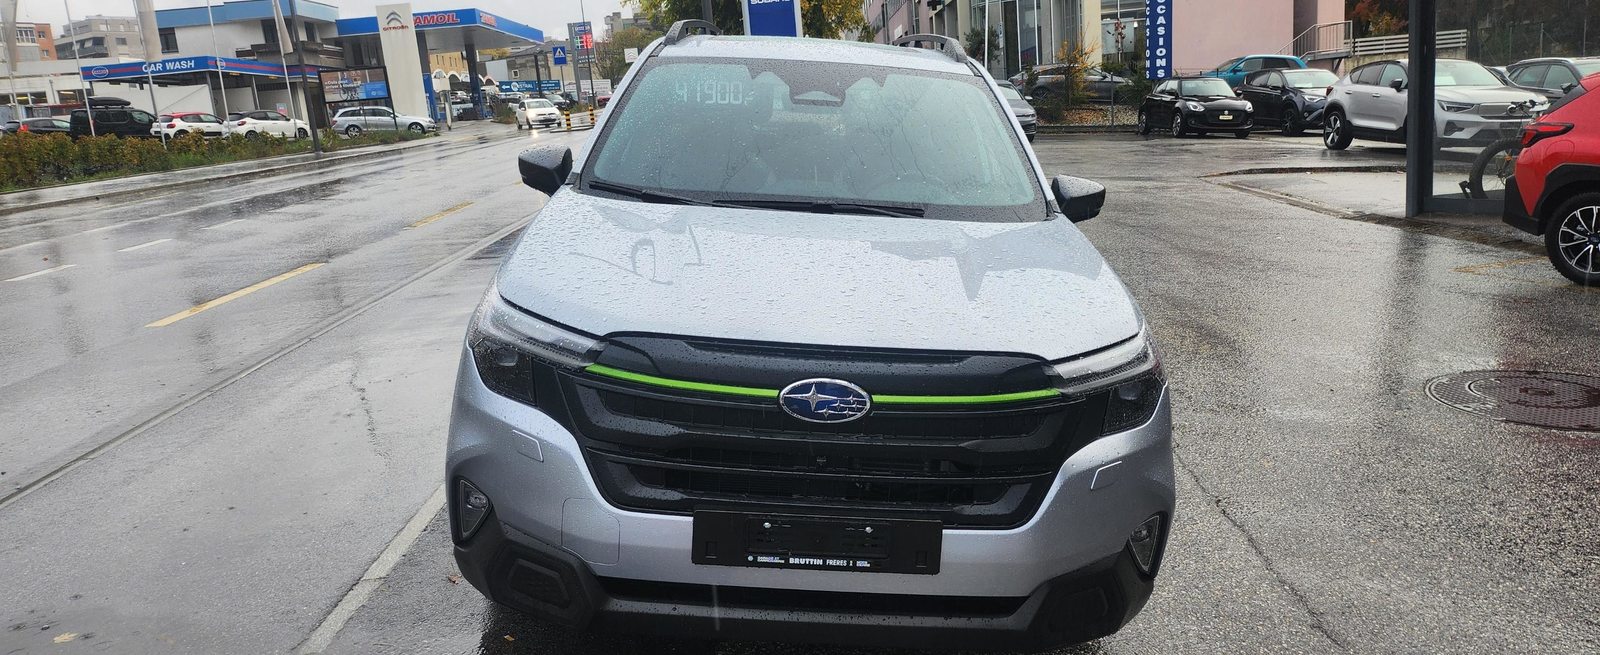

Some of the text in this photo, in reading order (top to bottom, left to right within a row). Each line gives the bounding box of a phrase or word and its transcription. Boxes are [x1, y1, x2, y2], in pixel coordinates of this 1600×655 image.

[142, 60, 195, 73] CAR WASH
[789, 557, 823, 566] BRUTTIN
